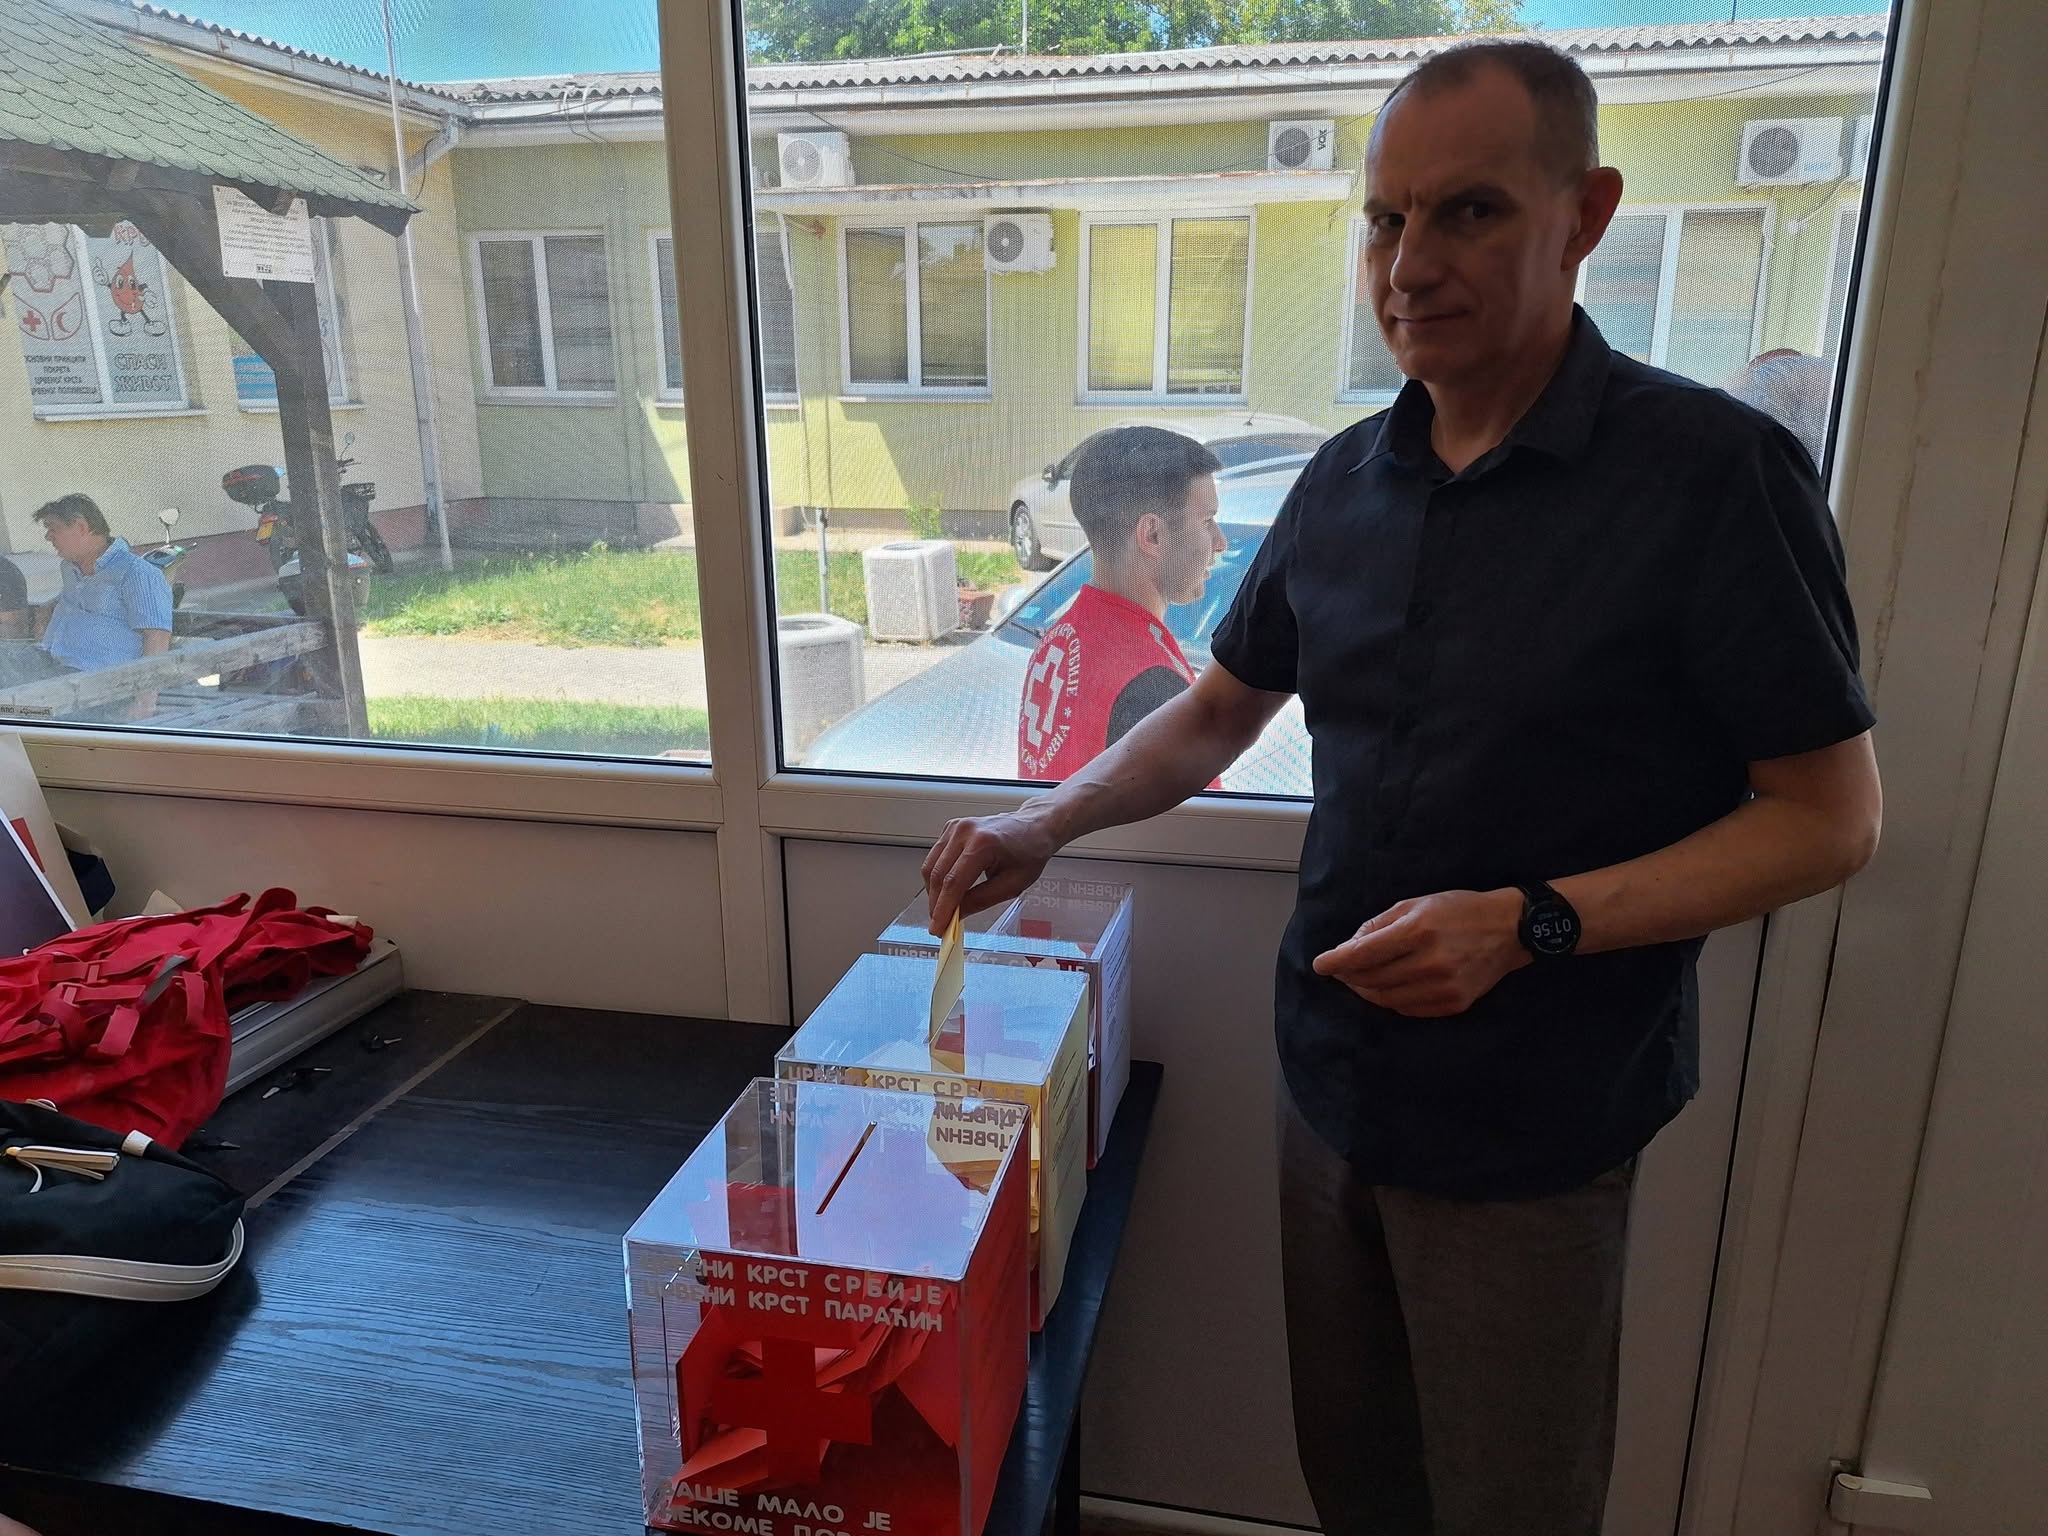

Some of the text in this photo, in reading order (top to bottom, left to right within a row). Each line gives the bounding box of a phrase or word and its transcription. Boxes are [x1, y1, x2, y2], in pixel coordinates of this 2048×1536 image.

[115, 353, 167, 370] СПАСИ
[115, 375, 171, 392] ЖИВОТ
[872, 1074, 921, 1093] КРСТ
[747, 1264, 808, 1289] КРСТ
[825, 1273, 941, 1305] СРБИЈЕ
[749, 1291, 810, 1315] КРСТ
[825, 1300, 942, 1332] ПАРАЋИН
[757, 1494, 844, 1524] МАЛО
[862, 1511, 891, 1531] ЈЕ
